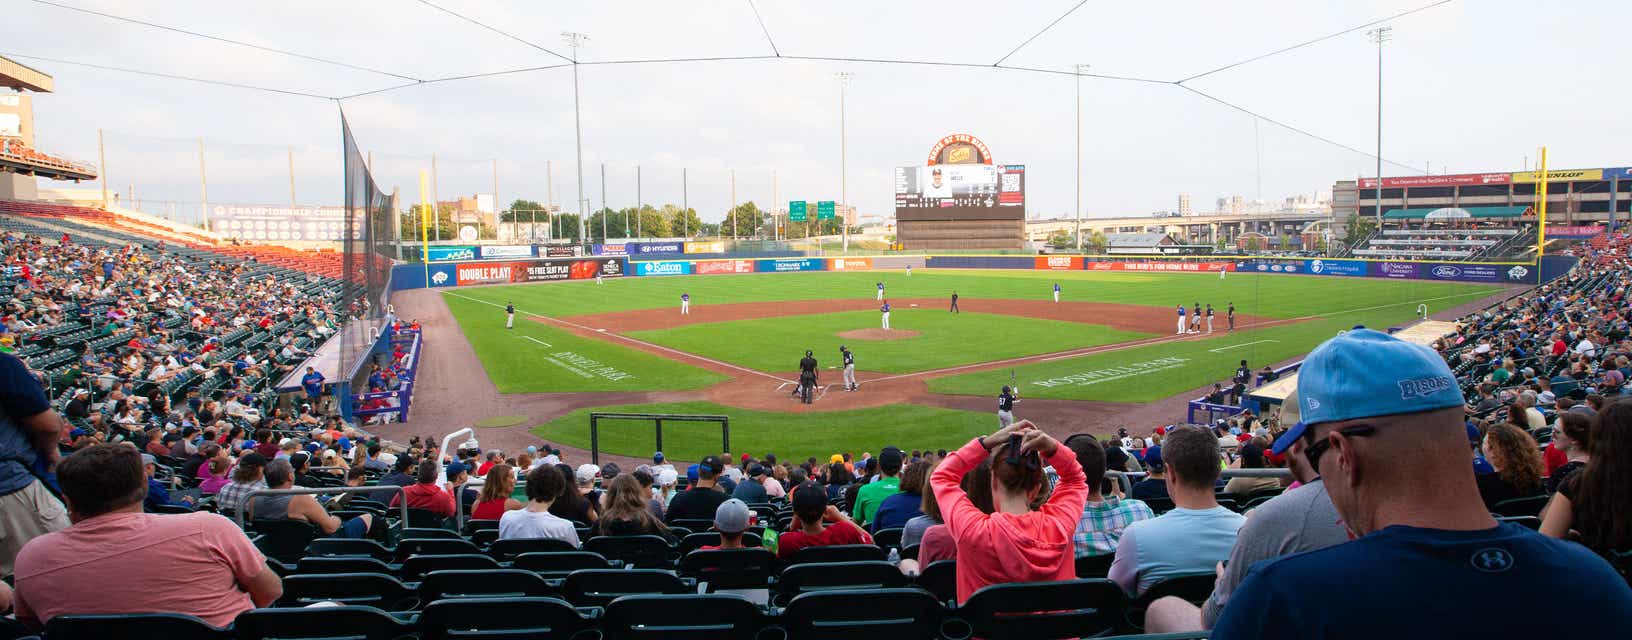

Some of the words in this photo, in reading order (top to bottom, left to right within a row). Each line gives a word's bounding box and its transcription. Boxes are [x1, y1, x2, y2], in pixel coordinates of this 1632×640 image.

[954, 134, 971, 143] THE
[535, 267, 546, 275] FREE
[654, 263, 682, 272] Eaton
[459, 268, 490, 281] DOUBLE
[490, 267, 511, 280] PLAY!
[1032, 367, 1141, 387] ROSWELL
[1398, 377, 1450, 400] BISONS
